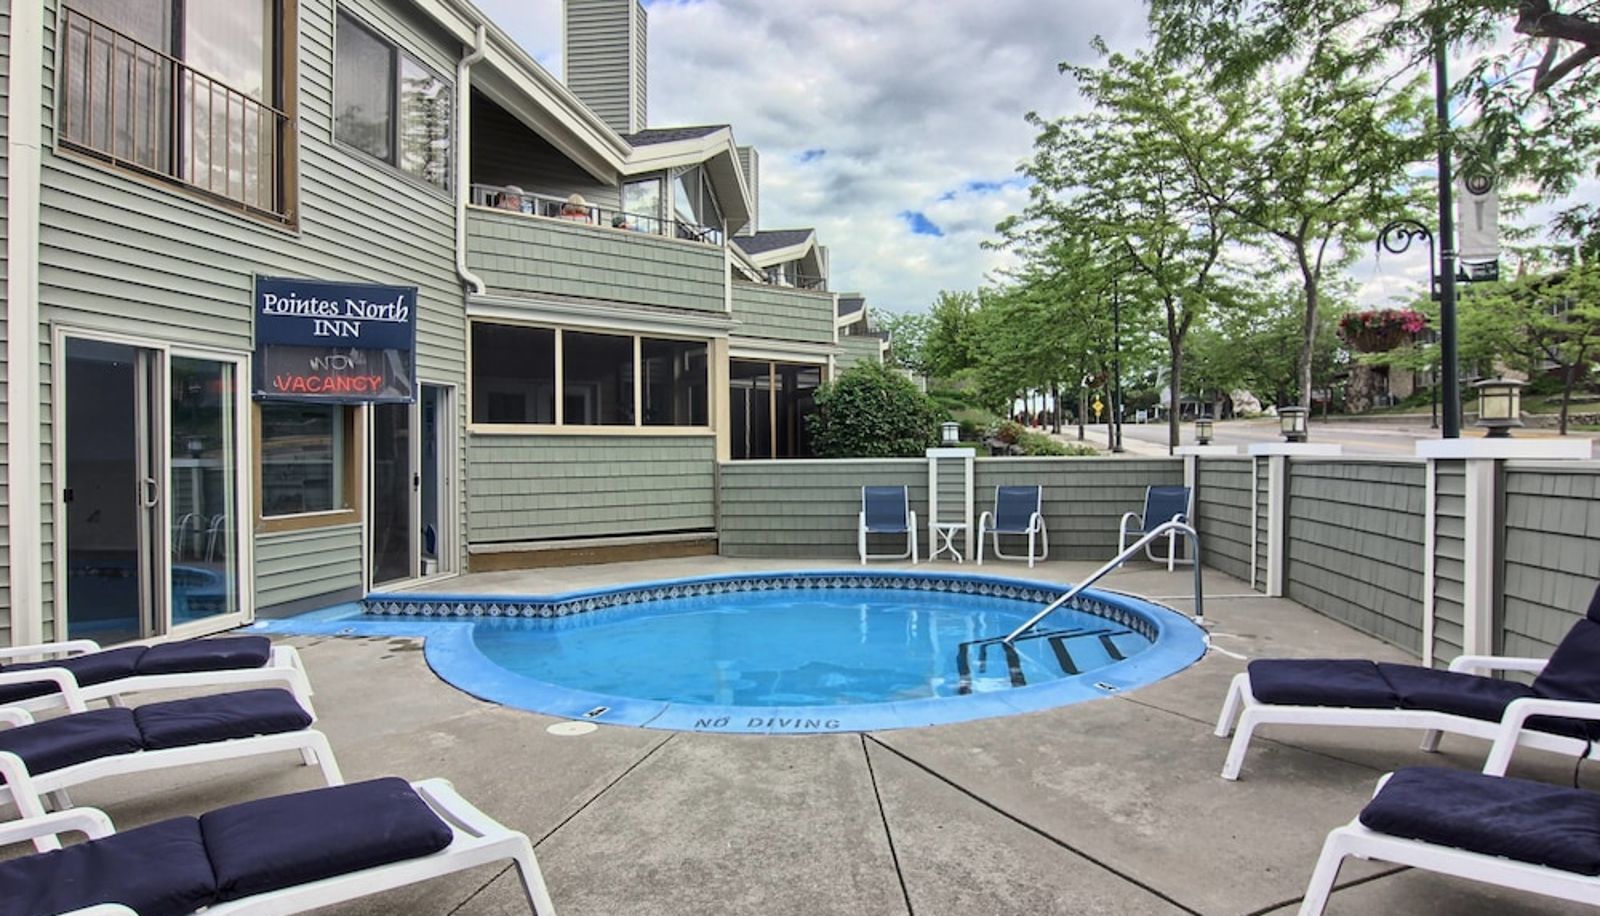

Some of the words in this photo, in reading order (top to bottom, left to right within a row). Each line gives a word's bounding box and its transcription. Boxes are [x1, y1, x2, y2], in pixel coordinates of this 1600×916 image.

[263, 292, 339, 317] Pointes
[345, 295, 409, 322] North
[313, 319, 361, 338] INN
[276, 375, 382, 393] VACANCY
[694, 716, 731, 728] NO
[747, 717, 841, 729] DIVING
